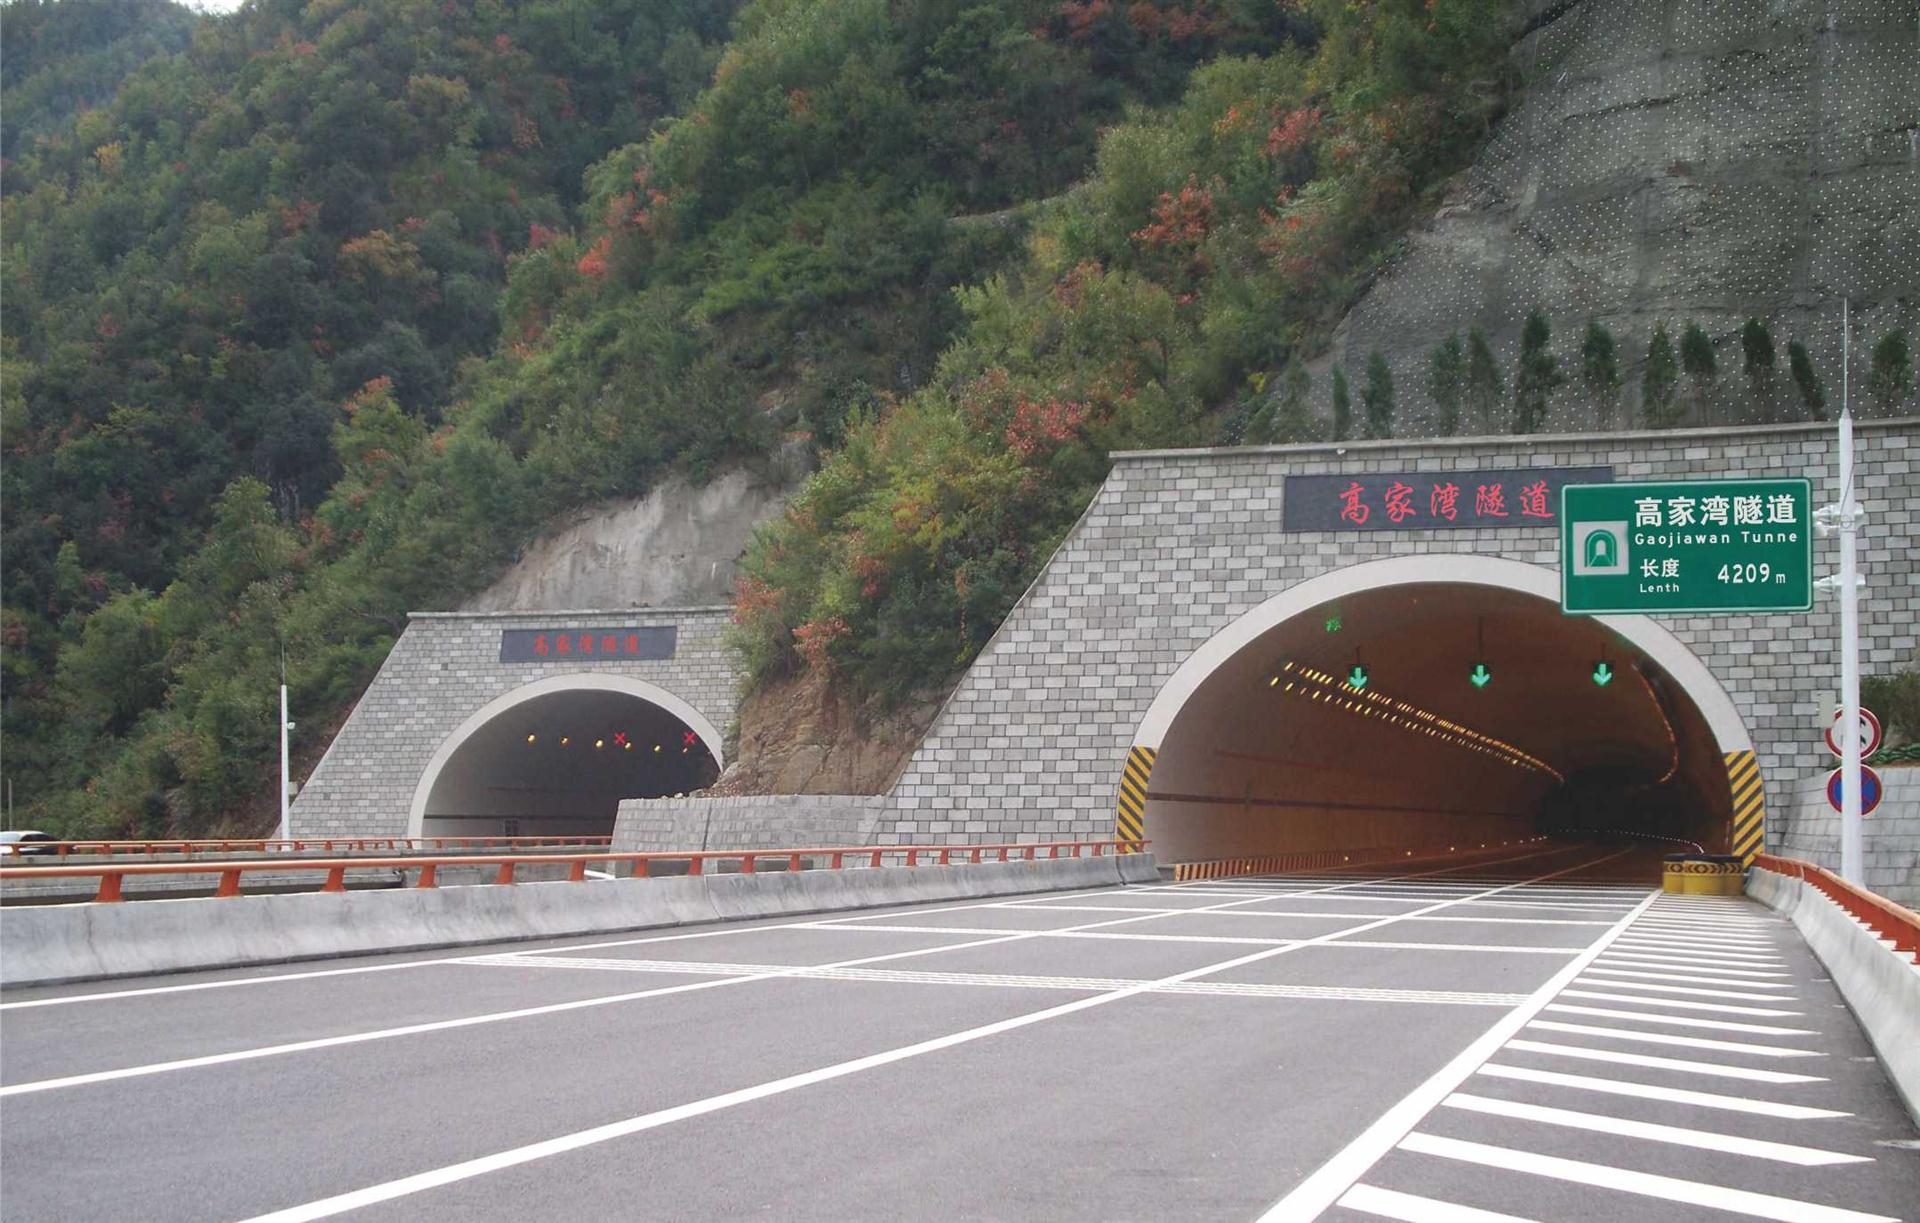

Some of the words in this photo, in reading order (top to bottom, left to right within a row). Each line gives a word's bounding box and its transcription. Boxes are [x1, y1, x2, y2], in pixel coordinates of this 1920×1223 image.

[1339, 479, 1554, 525] 高家湾隧道
[1634, 493, 1797, 527] 高家湾隧道
[1634, 532, 1730, 548] Gaojiawan
[1741, 530, 1798, 543] Tunne
[1639, 558, 1680, 578] 长度
[1717, 562, 1770, 584] 4209
[1775, 573, 1786, 584] m
[1639, 583, 1680, 593] Lenth
